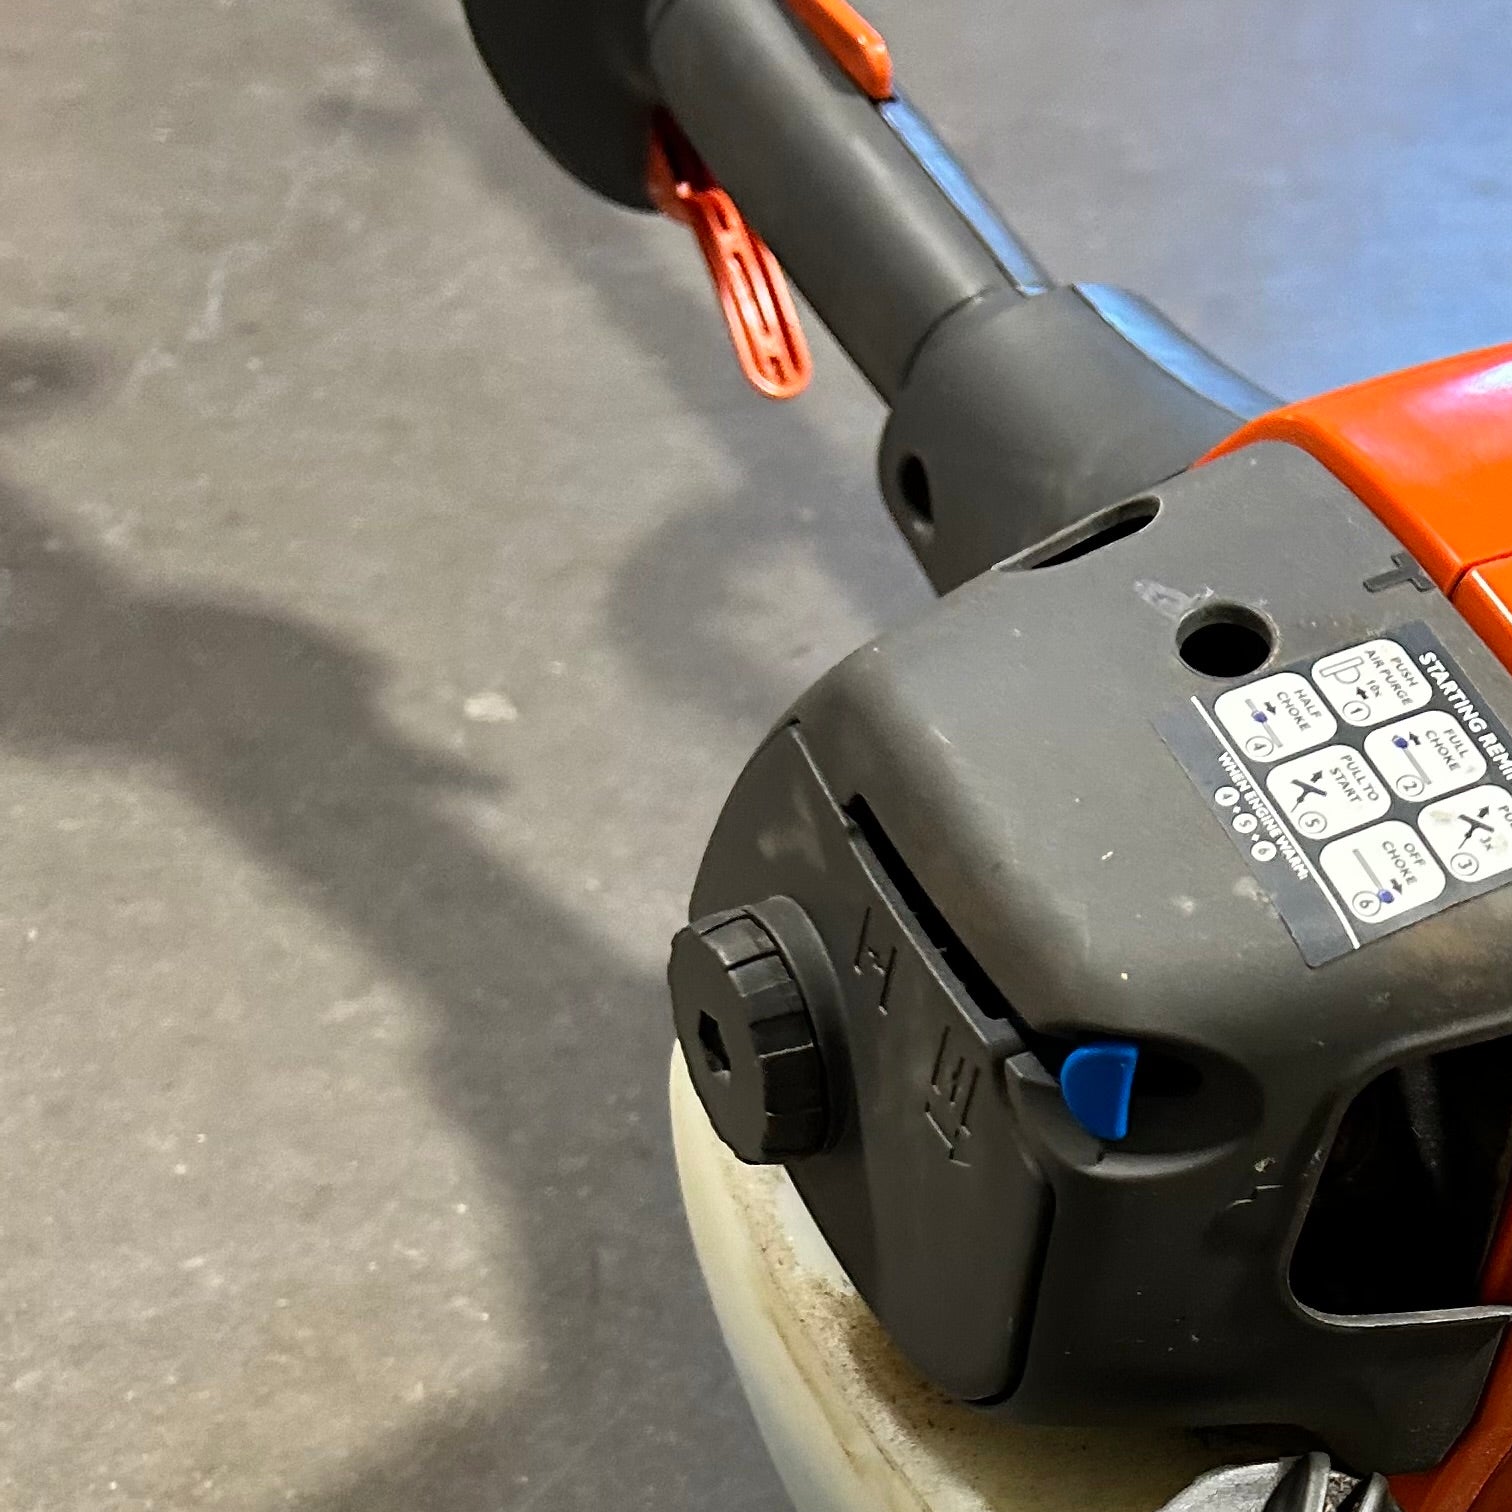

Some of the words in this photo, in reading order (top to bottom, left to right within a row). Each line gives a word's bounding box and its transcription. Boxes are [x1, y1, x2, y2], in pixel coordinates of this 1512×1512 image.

[1365, 650, 1382, 669] AIR
[1380, 668, 1413, 706] PURGE
[1390, 656, 1419, 687] PUSH
[1276, 691, 1311, 731] CHOKE
[1294, 689, 1322, 718] HALF
[1419, 651, 1487, 734] STARTING
[1425, 730, 1461, 772] CHOKE
[1443, 728, 1470, 758] FULL
[1218, 751, 1250, 793] WHEN
[1244, 790, 1283, 840] ENGINE
[1330, 767, 1362, 803] START
[1341, 754, 1366, 786] PULL
[1363, 782, 1379, 802] TO
[1382, 840, 1418, 885] CHOKE
[1403, 842, 1427, 867] OFF
